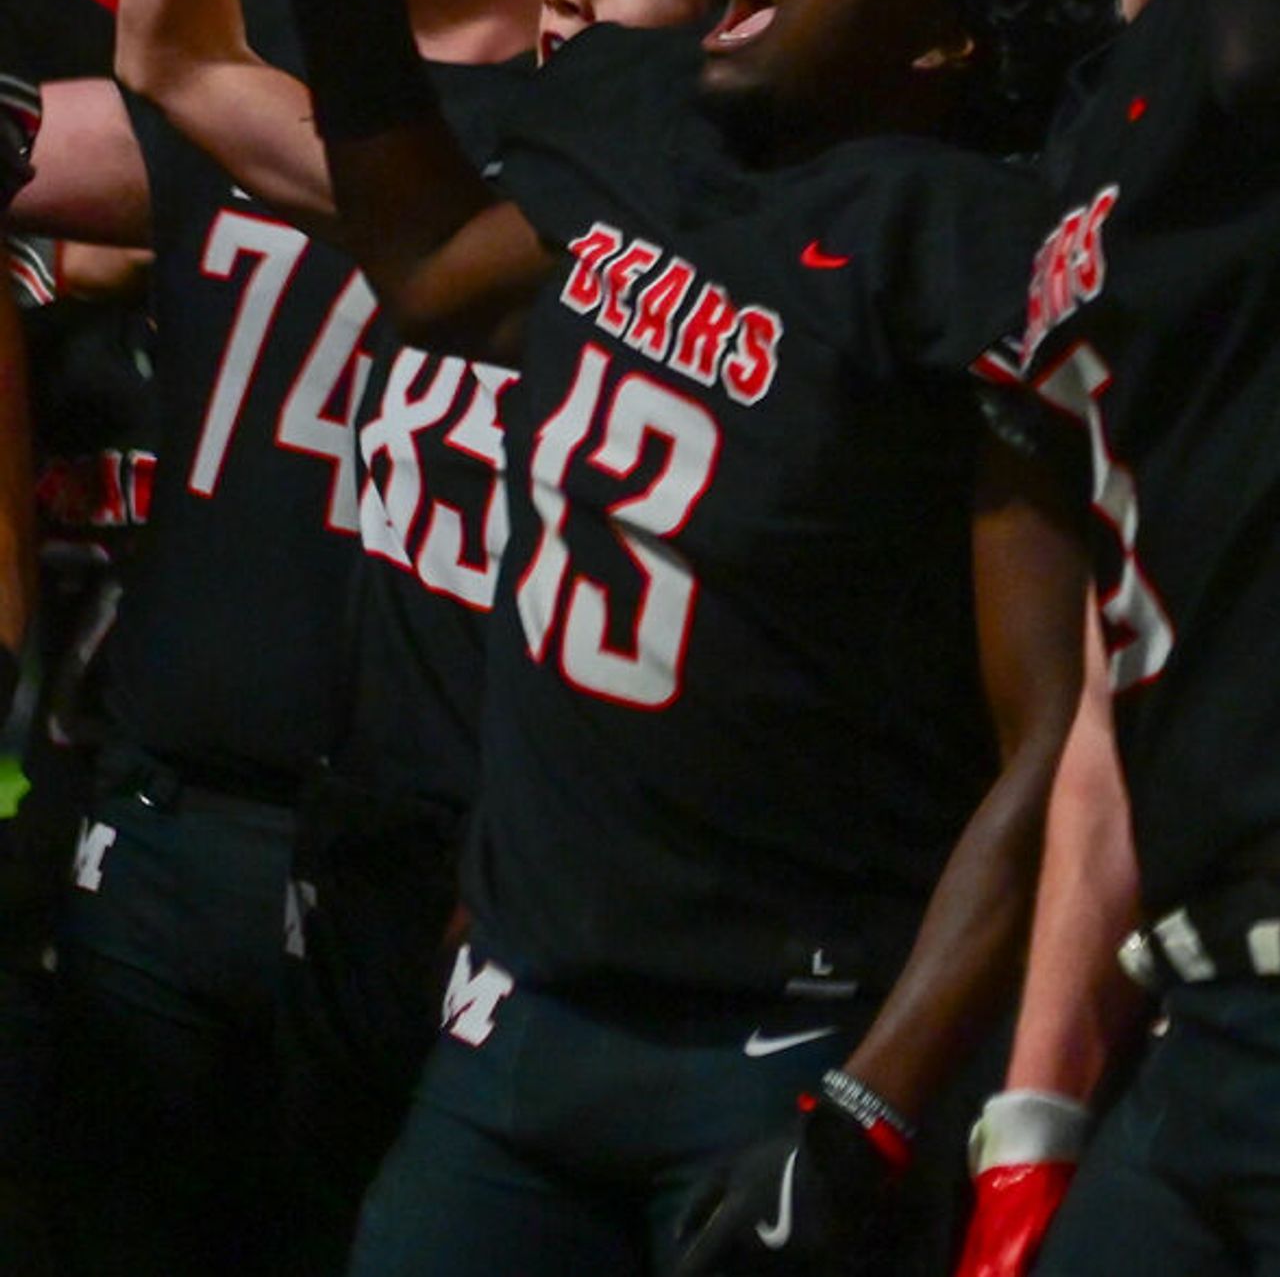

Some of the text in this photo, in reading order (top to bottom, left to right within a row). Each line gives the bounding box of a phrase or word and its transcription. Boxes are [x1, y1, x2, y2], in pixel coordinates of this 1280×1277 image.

[186, 207, 381, 536] 74
[559, 221, 783, 407] BEARS
[358, 345, 522, 613] 85
[515, 340, 724, 712] 13
[811, 947, 834, 977] L
